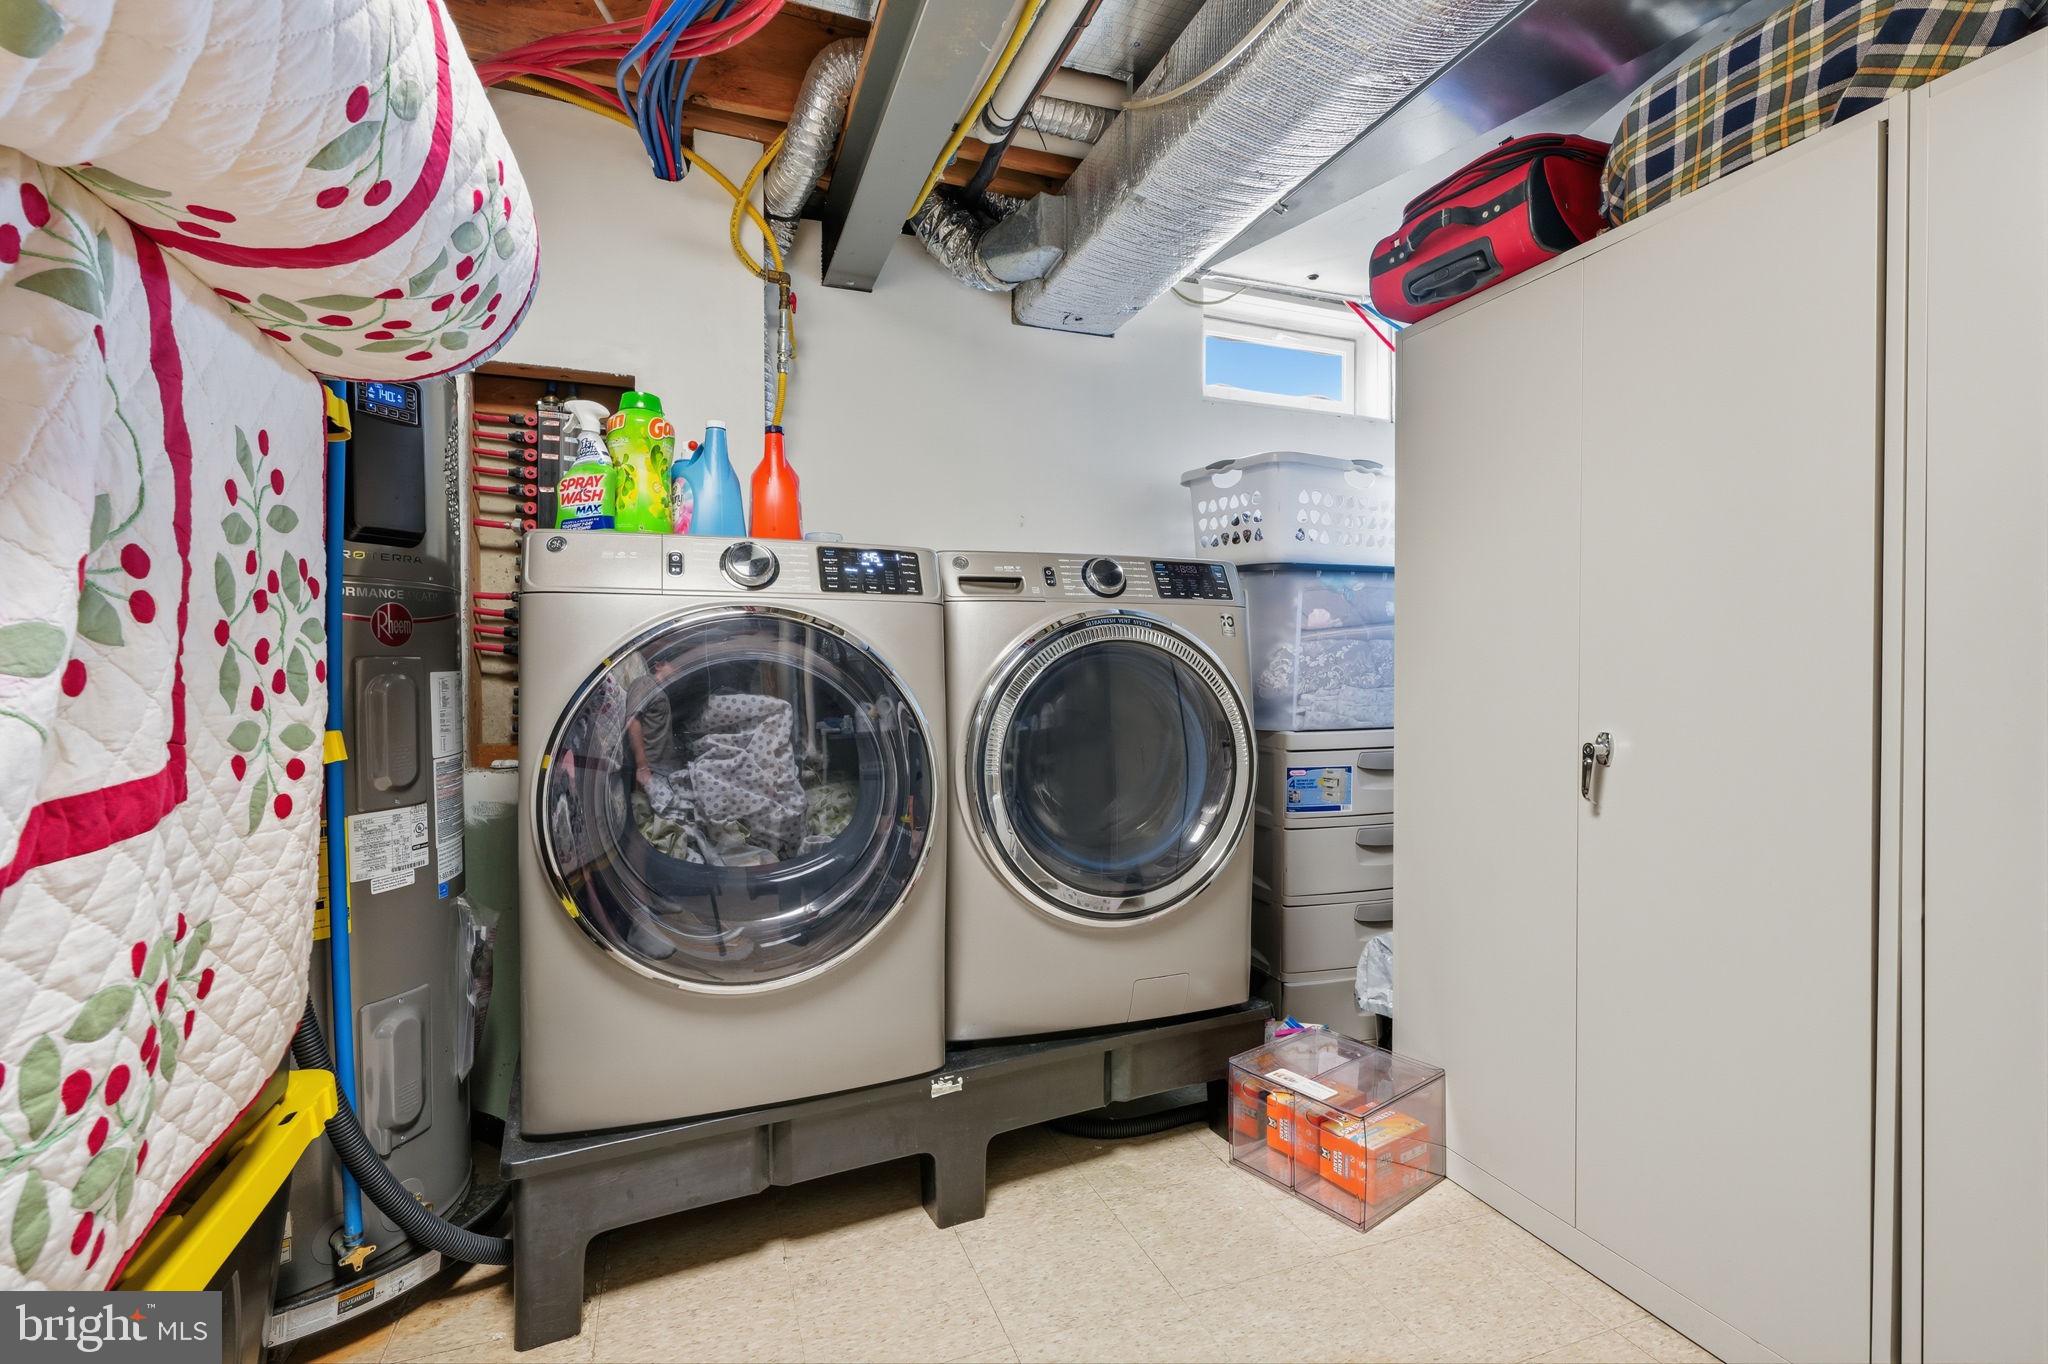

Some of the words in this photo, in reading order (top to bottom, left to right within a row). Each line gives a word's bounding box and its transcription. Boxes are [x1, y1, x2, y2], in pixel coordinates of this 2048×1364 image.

[560, 475, 604, 492] SPRAY
[560, 489, 604, 506] WASH
[576, 504, 602, 515] MAX
[376, 602, 412, 640] Rheem
